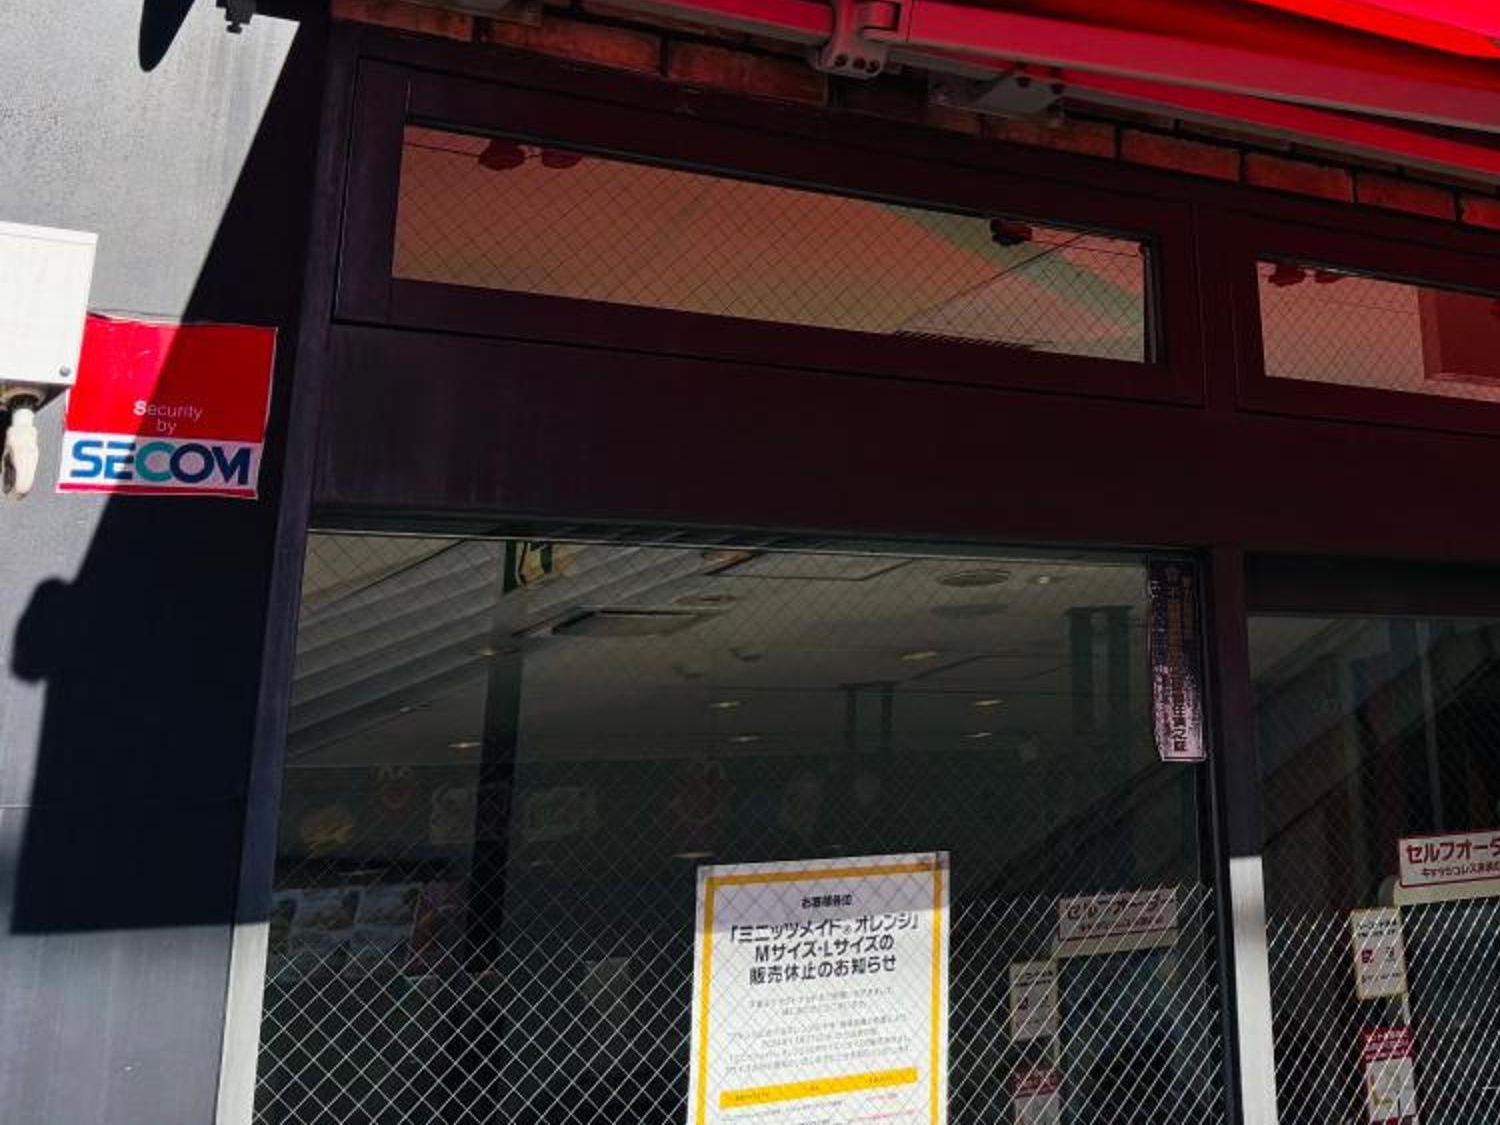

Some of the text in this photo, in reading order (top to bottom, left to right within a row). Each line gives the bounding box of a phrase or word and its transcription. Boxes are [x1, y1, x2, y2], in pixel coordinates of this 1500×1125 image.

[133, 399, 203, 423] Security
[157, 420, 177, 436] by
[69, 439, 251, 486] SECOM
[749, 955, 897, 986] 販売休止のお知らせ
